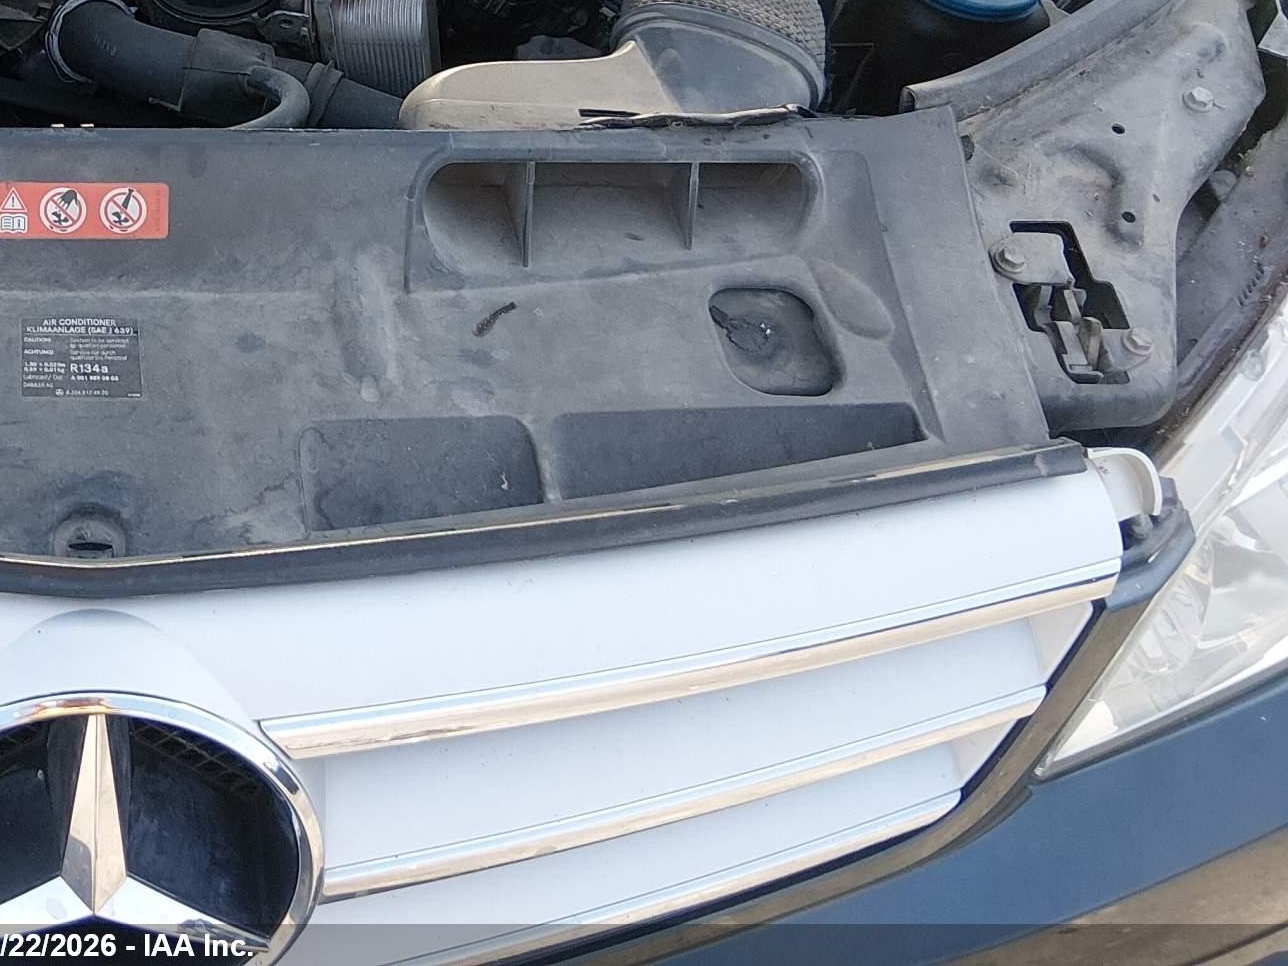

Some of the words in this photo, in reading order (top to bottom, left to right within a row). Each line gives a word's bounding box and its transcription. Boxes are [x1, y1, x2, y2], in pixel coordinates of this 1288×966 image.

[43, 318, 57, 326] AIR
[58, 318, 116, 326] CONDITIONER
[26, 325, 86, 334] KLIMAANLAGE
[88, 326, 107, 335] (SAE
[114, 327, 133, 335] 639)
[70, 362, 109, 374] R134a
